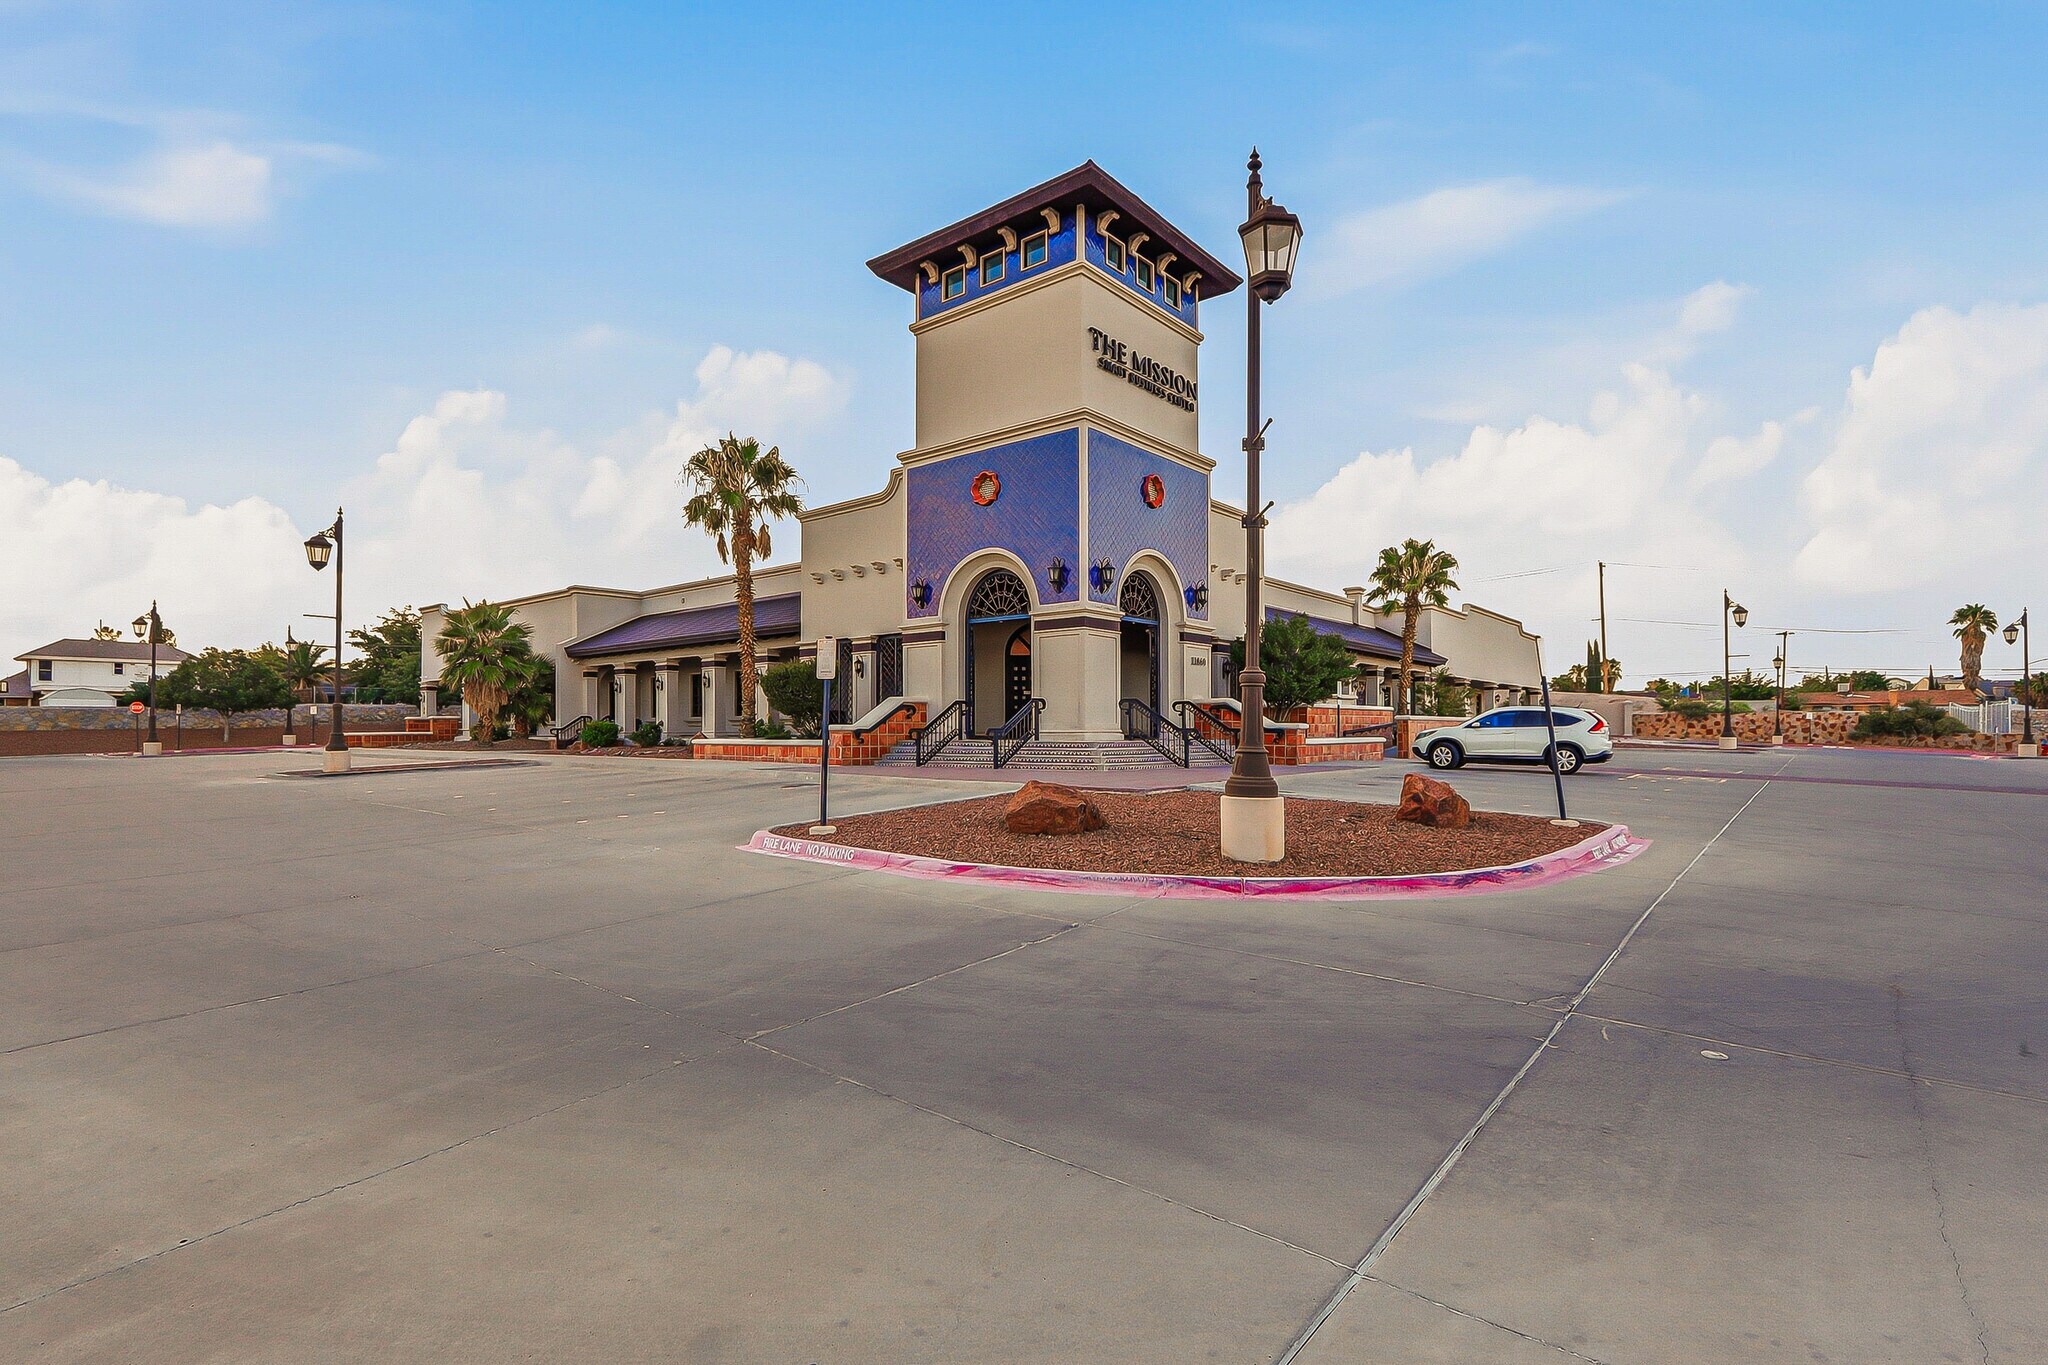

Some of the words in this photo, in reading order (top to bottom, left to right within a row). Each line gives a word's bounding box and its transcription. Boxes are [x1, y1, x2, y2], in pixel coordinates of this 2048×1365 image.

[1088, 326, 1127, 365] THE
[1131, 350, 1197, 400] MISSION
[763, 837, 780, 849] FIRE
[779, 839, 802, 853] LANE
[806, 844, 819, 856] NO
[818, 846, 855, 860] PARKING
